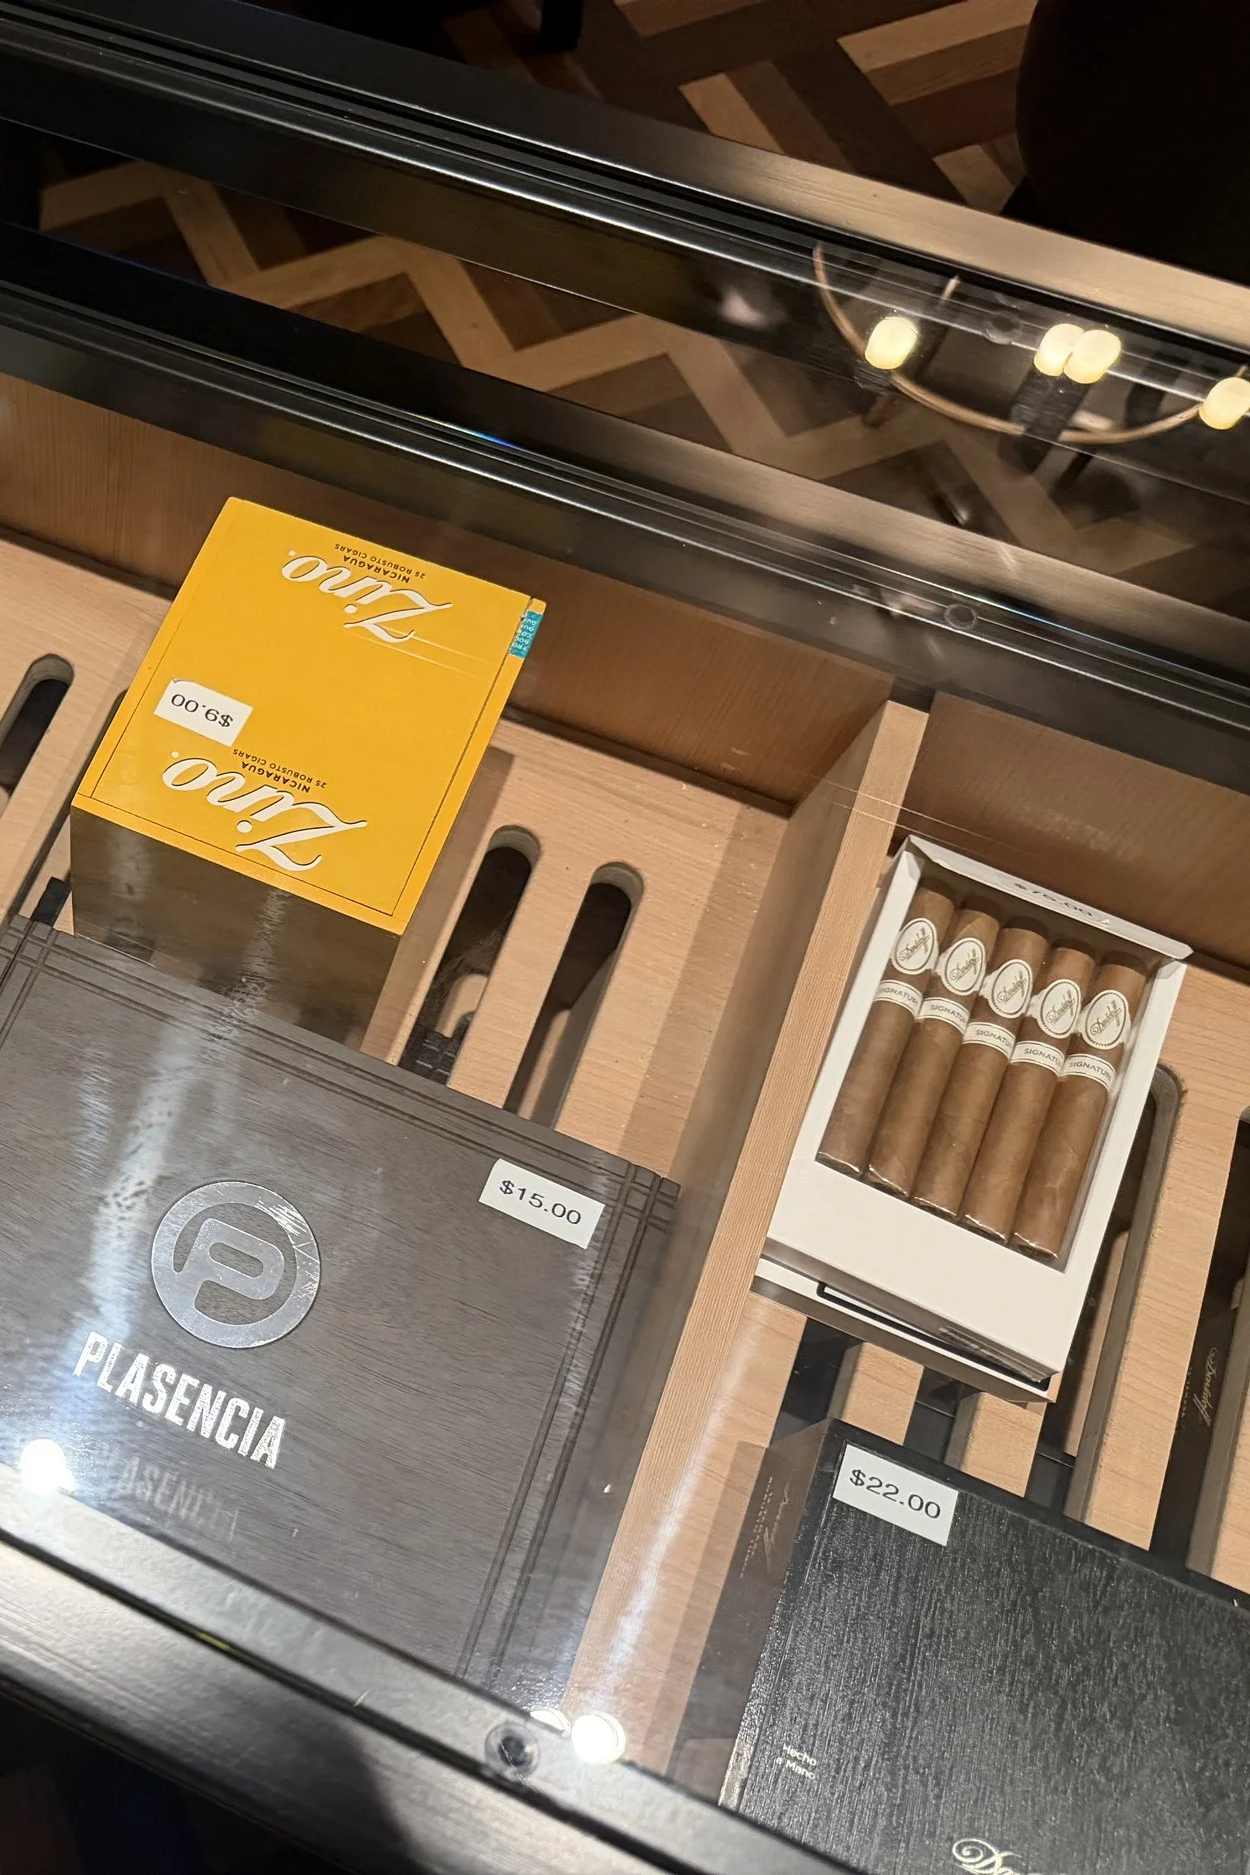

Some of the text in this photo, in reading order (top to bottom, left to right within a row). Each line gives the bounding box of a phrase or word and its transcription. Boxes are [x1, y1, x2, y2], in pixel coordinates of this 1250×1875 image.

[334, 543, 426, 579] 25 ROBUSTO CIGARS
[343, 555, 410, 584] NICARAGUA
[171, 693, 234, 728] $9.00
[232, 748, 327, 789] 25 ROBUSTO CIGARS
[241, 761, 311, 793] NICARAGUA
[499, 1180, 581, 1225] $15.00
[72, 1331, 286, 1470] PLASENCIA
[849, 1469, 941, 1519] $22.00
[783, 1743, 817, 1766] Hecho
[786, 1760, 815, 1779] Mano
